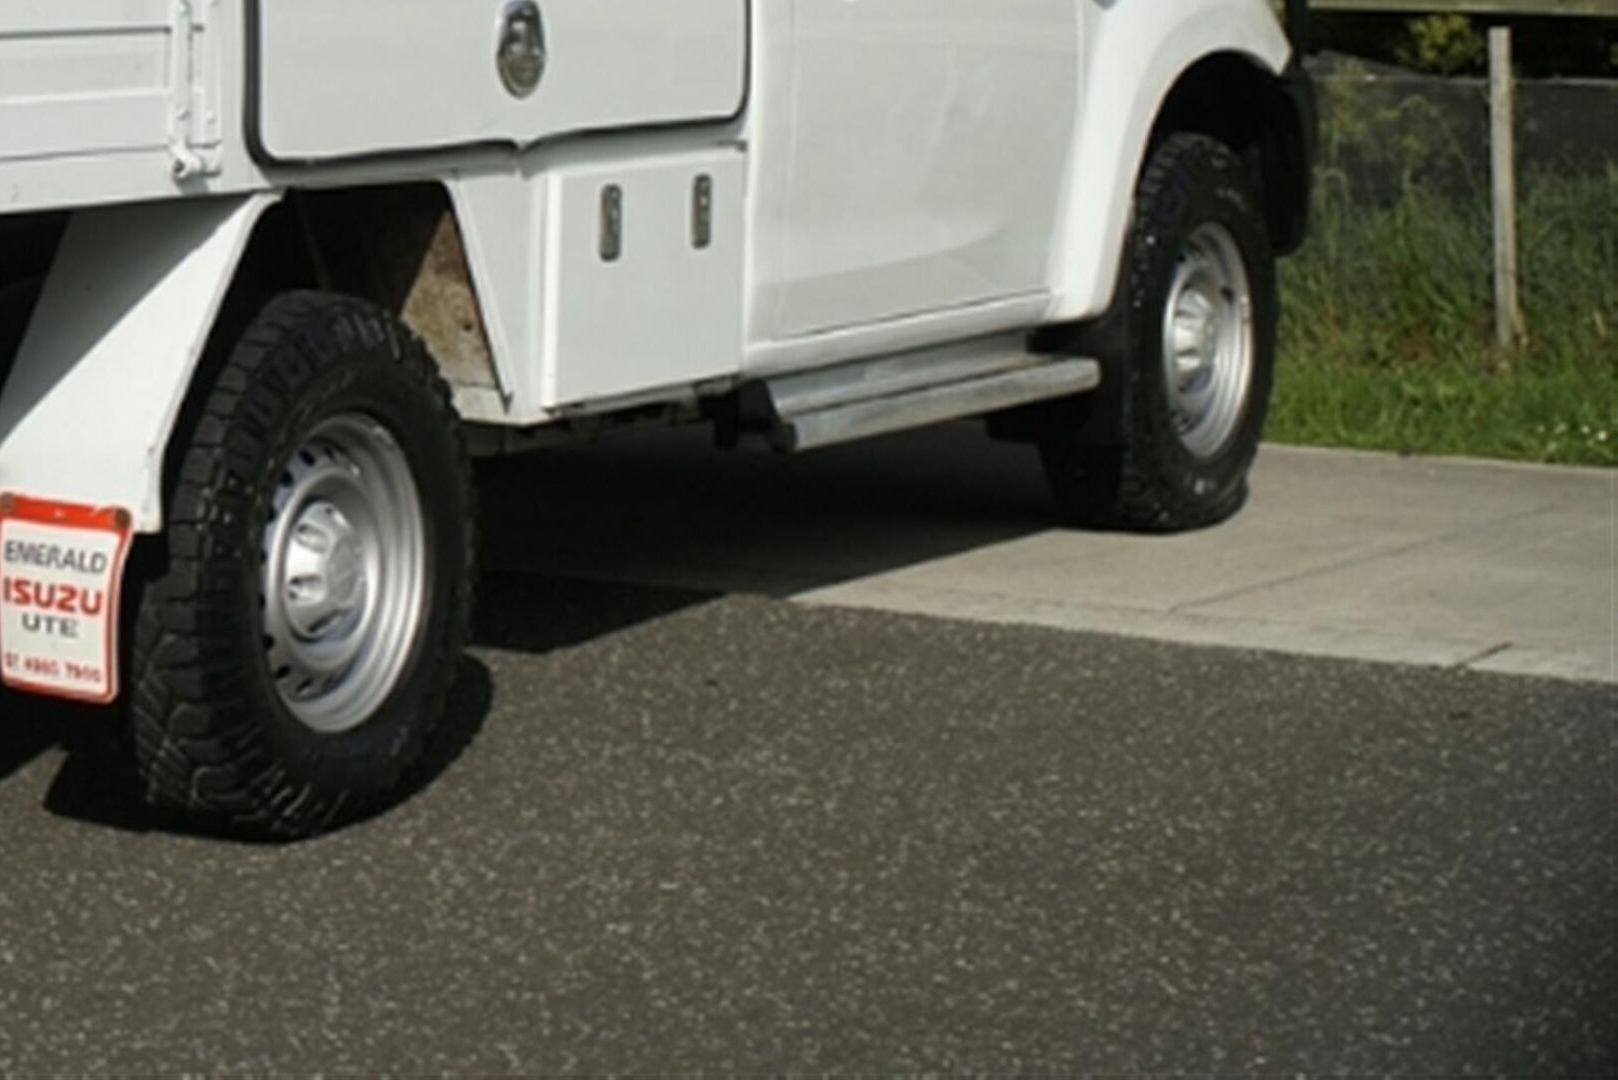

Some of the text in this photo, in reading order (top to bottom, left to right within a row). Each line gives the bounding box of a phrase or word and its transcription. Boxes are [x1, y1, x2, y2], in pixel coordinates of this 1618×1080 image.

[4, 539, 108, 574] EMERALD
[3, 576, 103, 616] ISUZU
[21, 613, 80, 638] UTE
